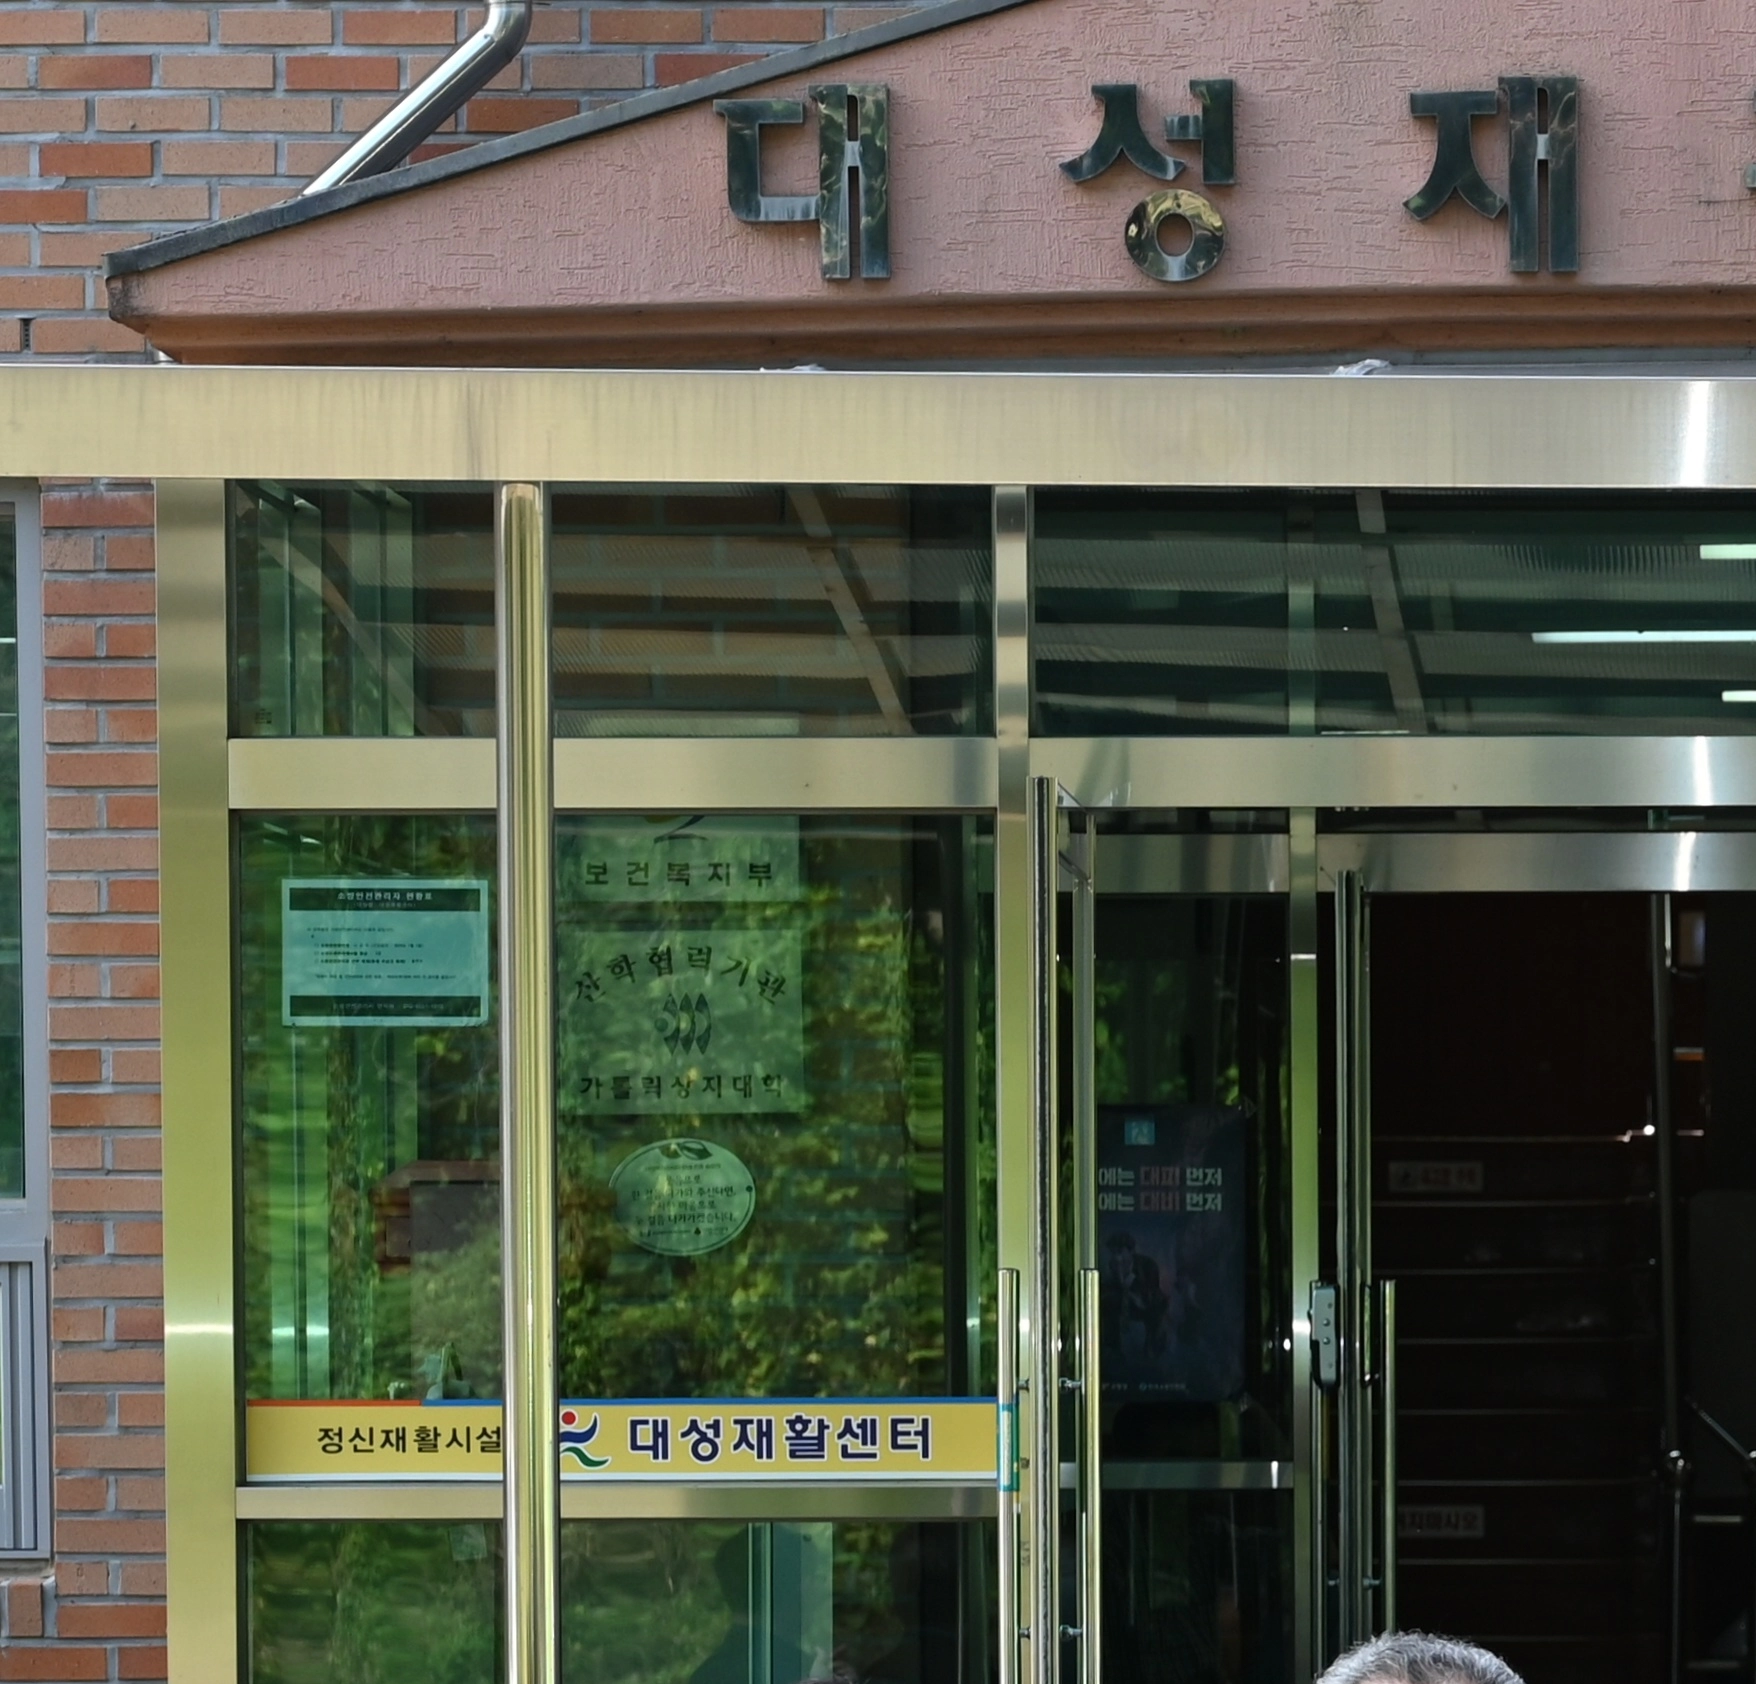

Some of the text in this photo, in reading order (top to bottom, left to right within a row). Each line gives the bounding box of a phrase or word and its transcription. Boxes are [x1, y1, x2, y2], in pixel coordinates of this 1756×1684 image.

[583, 861, 775, 889] 보건복지부
[1185, 1167, 1223, 1187] 먼저
[1185, 1192, 1223, 1212] 먼저
[317, 1424, 502, 1455] 정신재활시설
[629, 1413, 932, 1462] 대성재활센터
